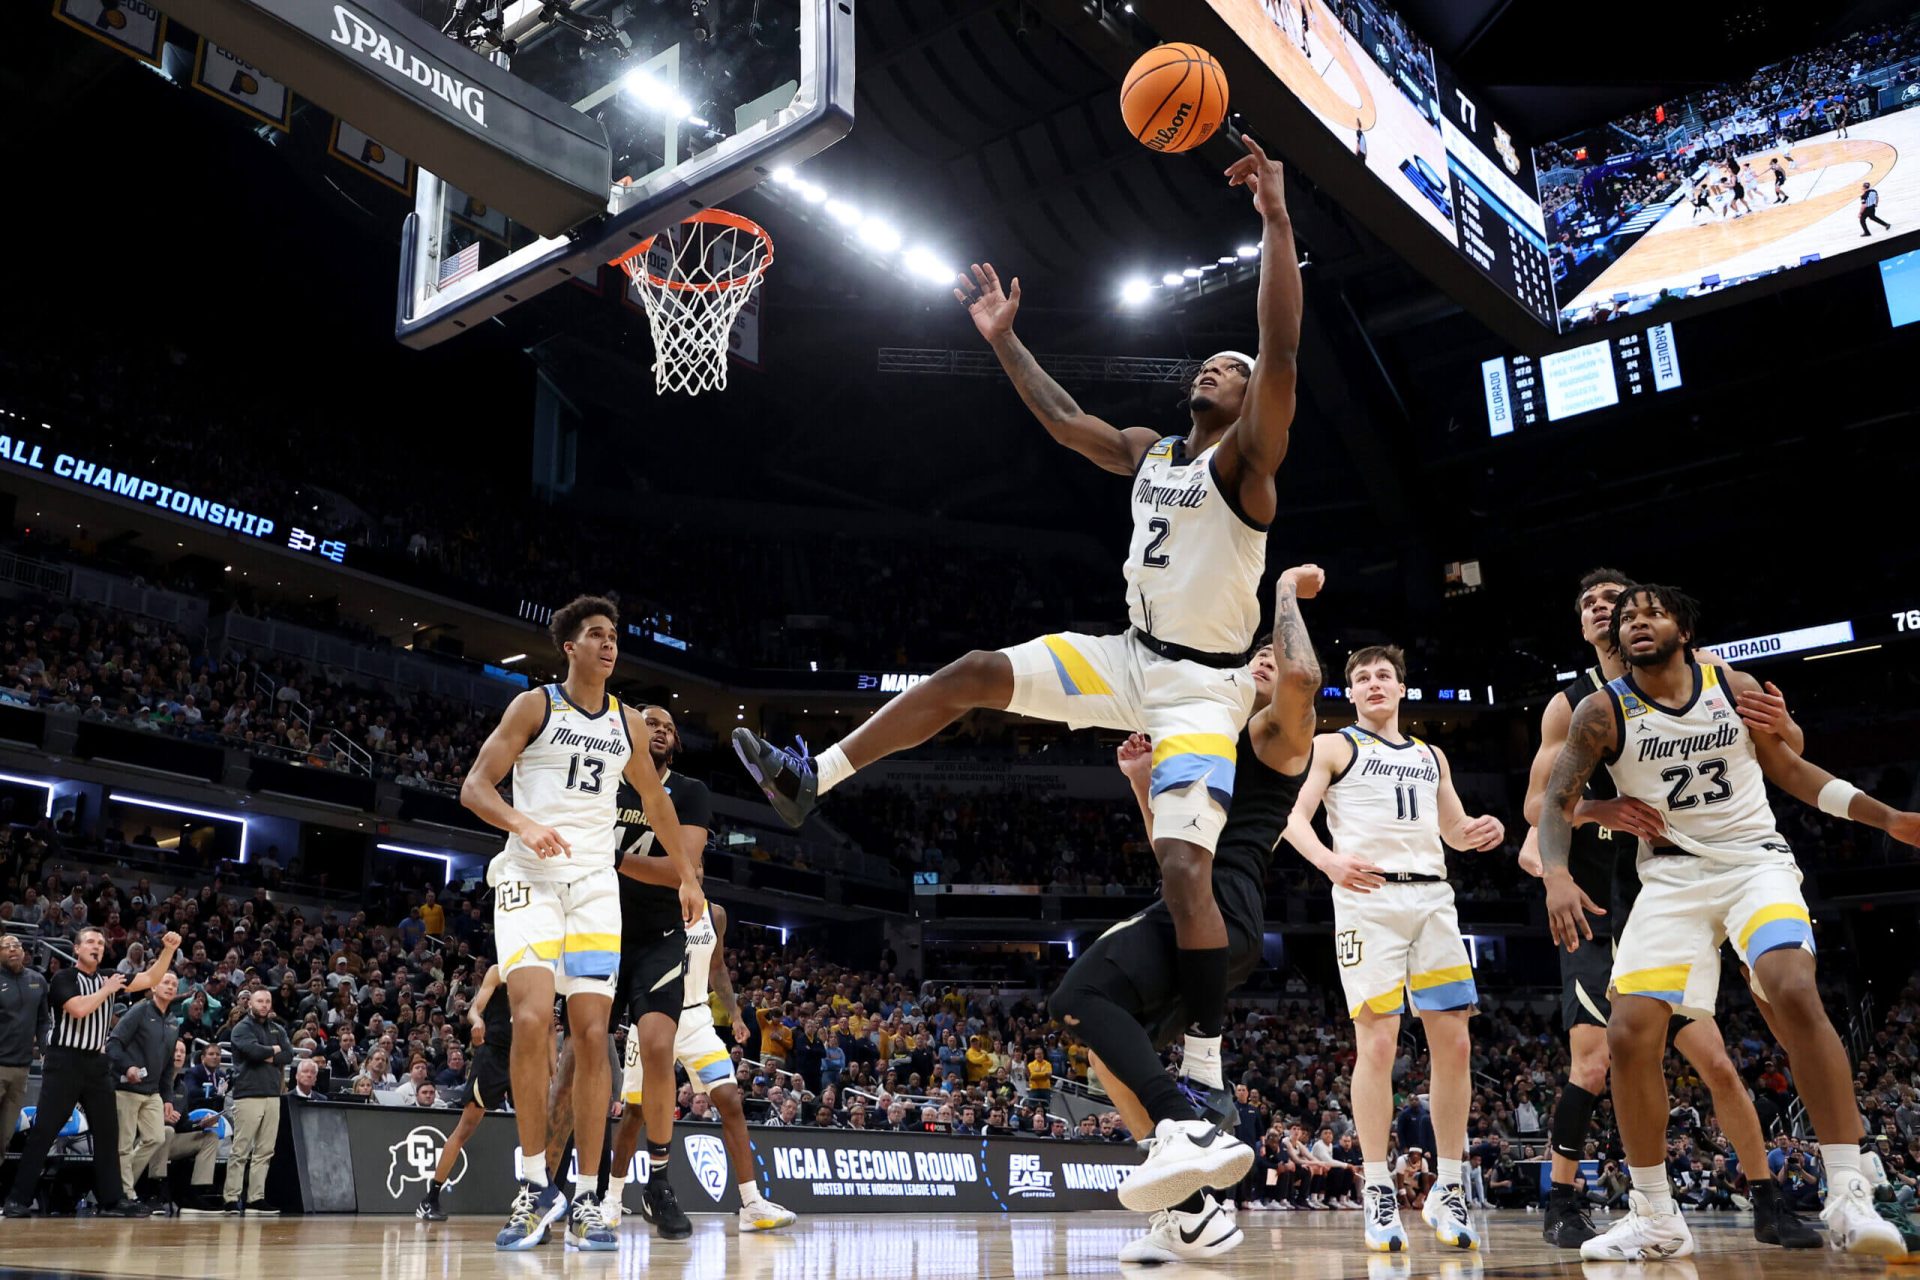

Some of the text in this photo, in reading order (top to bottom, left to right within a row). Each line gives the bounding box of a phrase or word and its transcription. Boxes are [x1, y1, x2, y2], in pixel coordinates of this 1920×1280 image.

[331, 5, 486, 127] SPALDING
[1146, 102, 1195, 150] Wilson
[1456, 88, 1476, 133] 77
[1653, 325, 1673, 380] MARQUETTE
[1489, 371, 1506, 421] COLORADO
[53, 454, 274, 538] CHAMPIONSHIP
[1135, 478, 1208, 512] Marquette
[1143, 516, 1170, 569] 2
[1892, 610, 1920, 631] 76
[1438, 689, 1455, 699] AST
[1458, 689, 1471, 701] 21
[550, 727, 625, 757] Marquette
[1636, 722, 1739, 762] Marquette
[565, 752, 606, 795] 13
[1361, 758, 1438, 784] Marquette
[1661, 757, 1733, 811] 23
[1395, 783, 1419, 821] 11
[497, 880, 531, 912] MU
[1337, 930, 1363, 968] MU
[705, 1170, 721, 1188] 12
[774, 1147, 978, 1182] NCAA SECOND ROUND
[1009, 1154, 1040, 1171] BIG
[1009, 1171, 1053, 1187] EAST
[812, 1182, 843, 1196] HOSTED
[844, 1183, 855, 1196] BY
[855, 1183, 871, 1196] THE
[871, 1183, 904, 1196] HORIZON
[904, 1184, 930, 1196] LEAGUE
